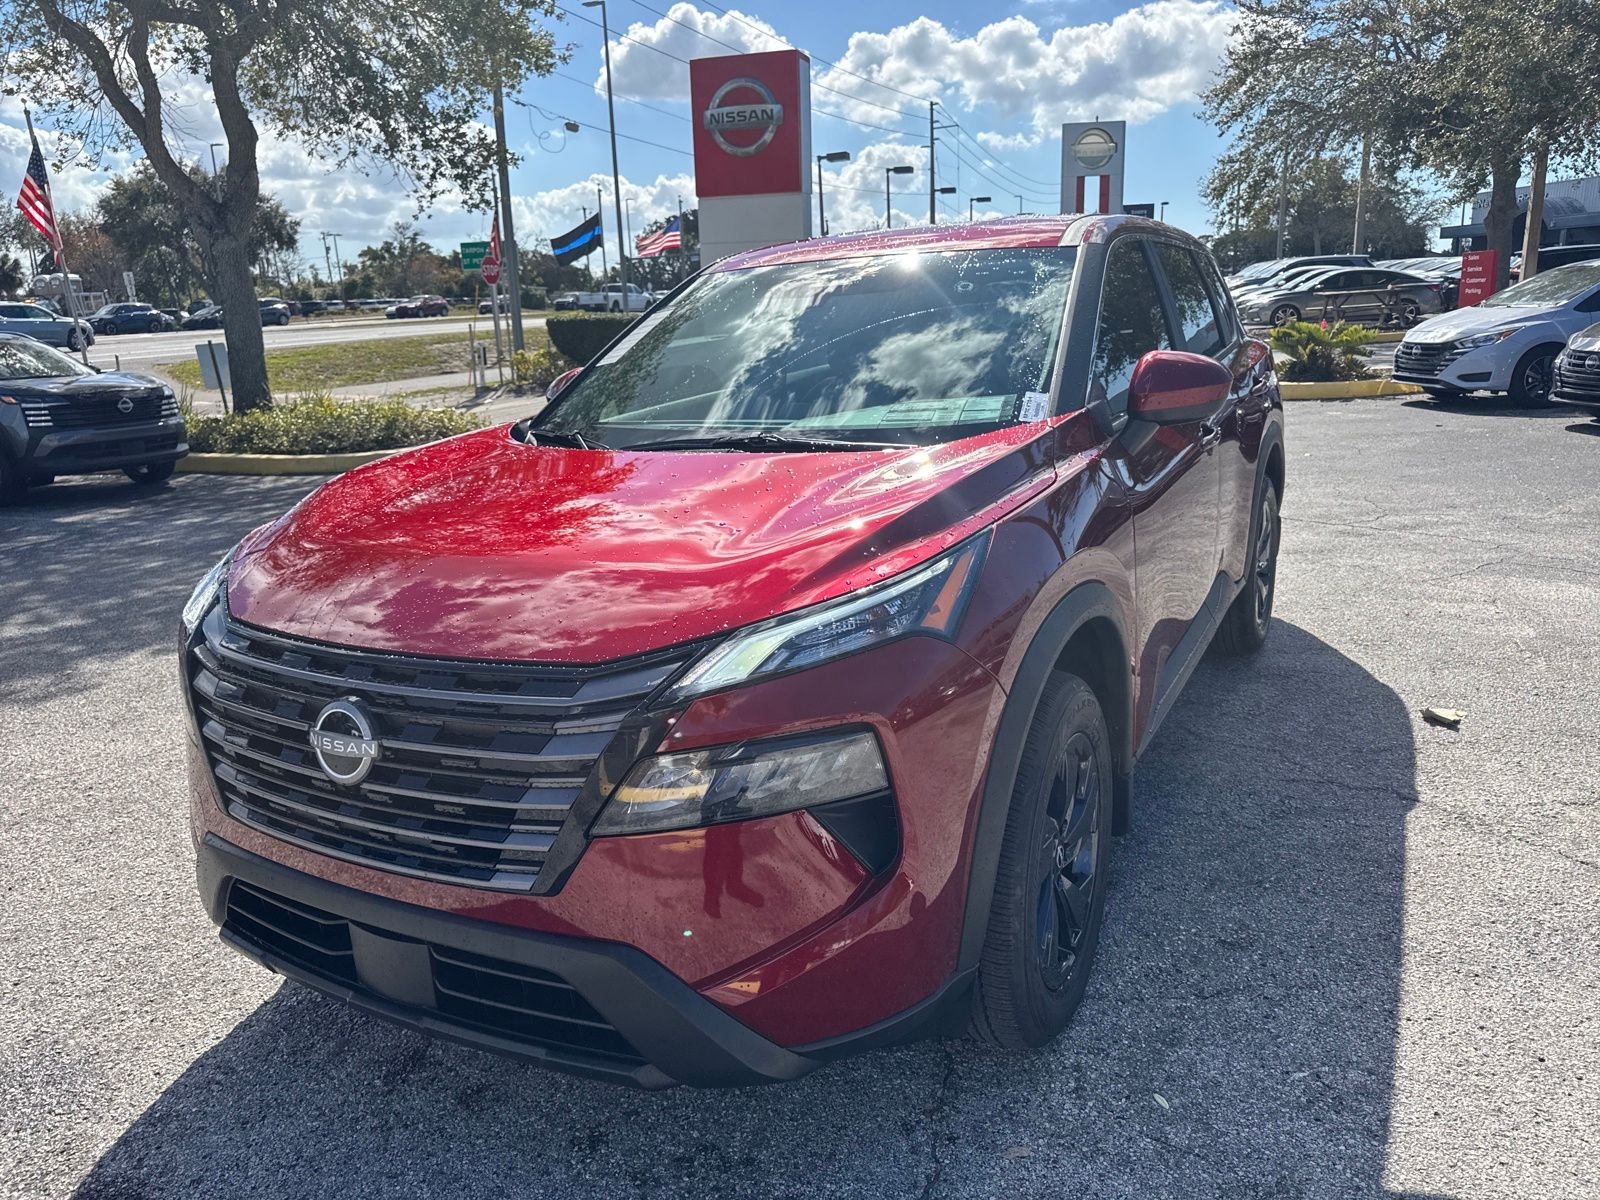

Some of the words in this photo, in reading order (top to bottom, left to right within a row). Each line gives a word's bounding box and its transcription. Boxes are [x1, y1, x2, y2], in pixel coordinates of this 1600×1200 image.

[709, 108, 775, 125] NISSAN
[482, 264, 500, 276] STOP
[309, 731, 376, 755] NISSAN
